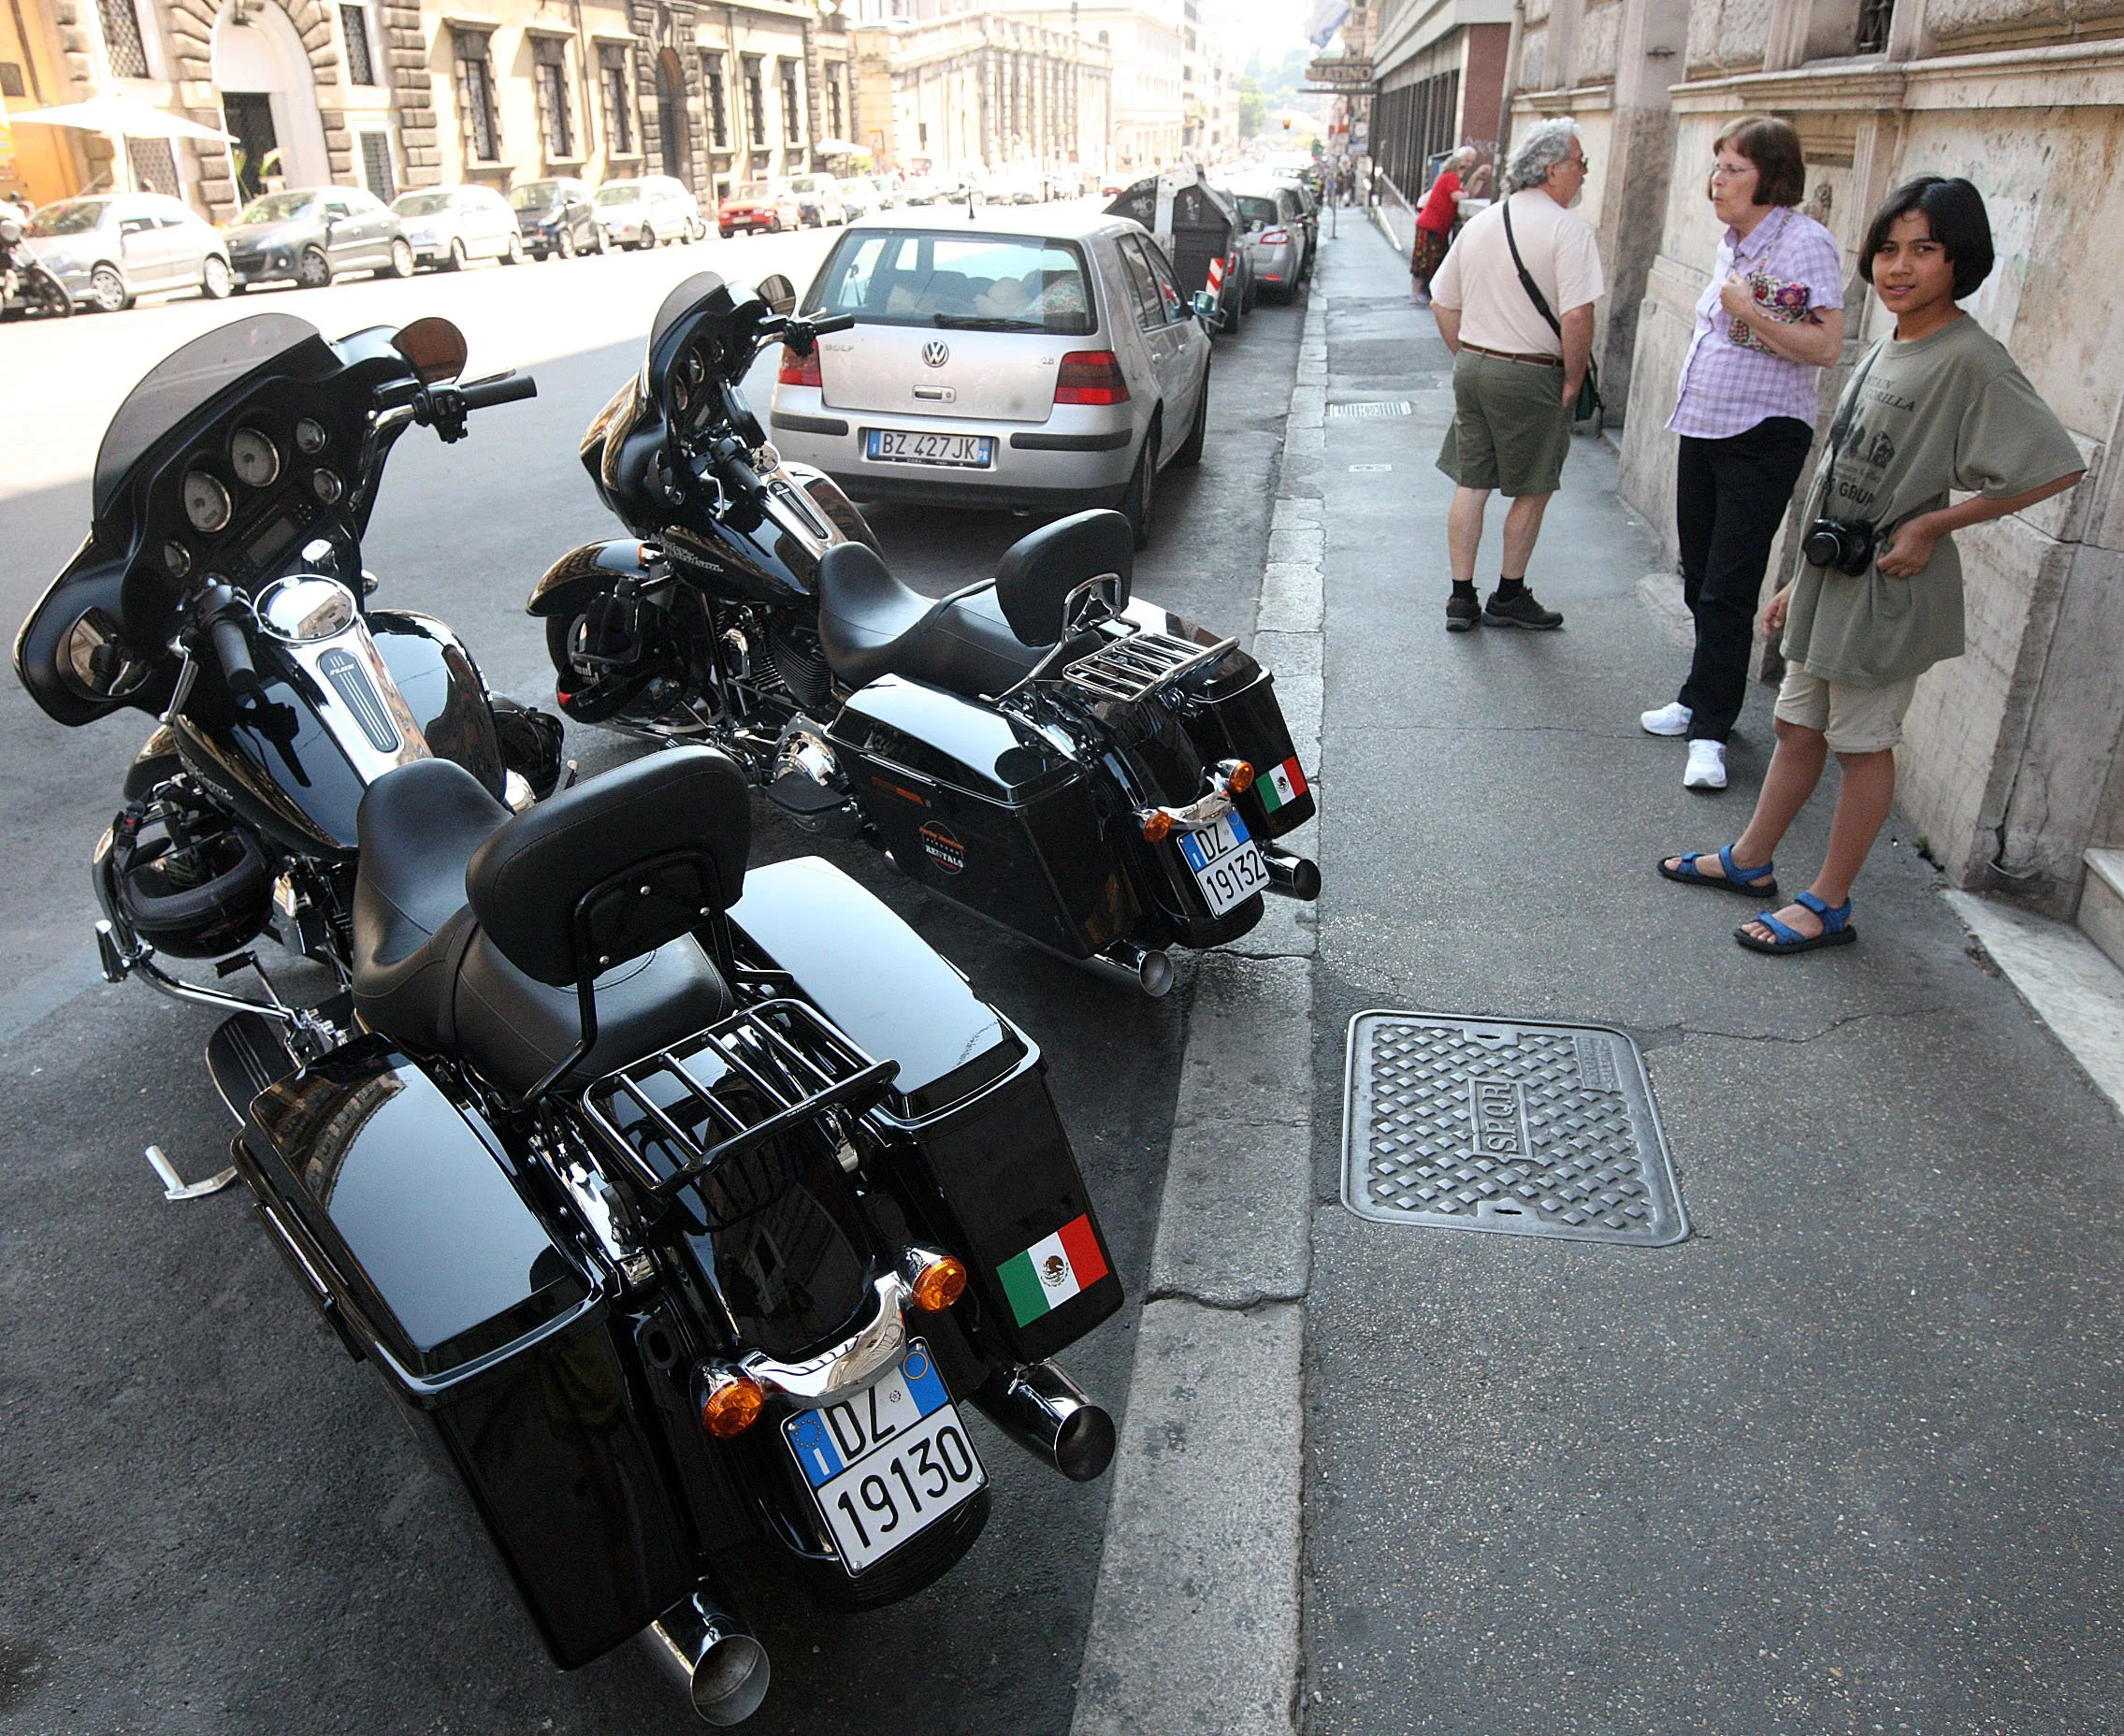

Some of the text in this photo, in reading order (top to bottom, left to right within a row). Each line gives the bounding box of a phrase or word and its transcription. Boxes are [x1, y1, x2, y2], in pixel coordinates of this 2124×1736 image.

[882, 433, 906, 456] BZ
[924, 844, 964, 868] RENTALS
[1194, 823, 1229, 861] DZ
[1206, 849, 1266, 905] 19132
[823, 1385, 896, 1461] DZ
[837, 1425, 974, 1549] 19130
